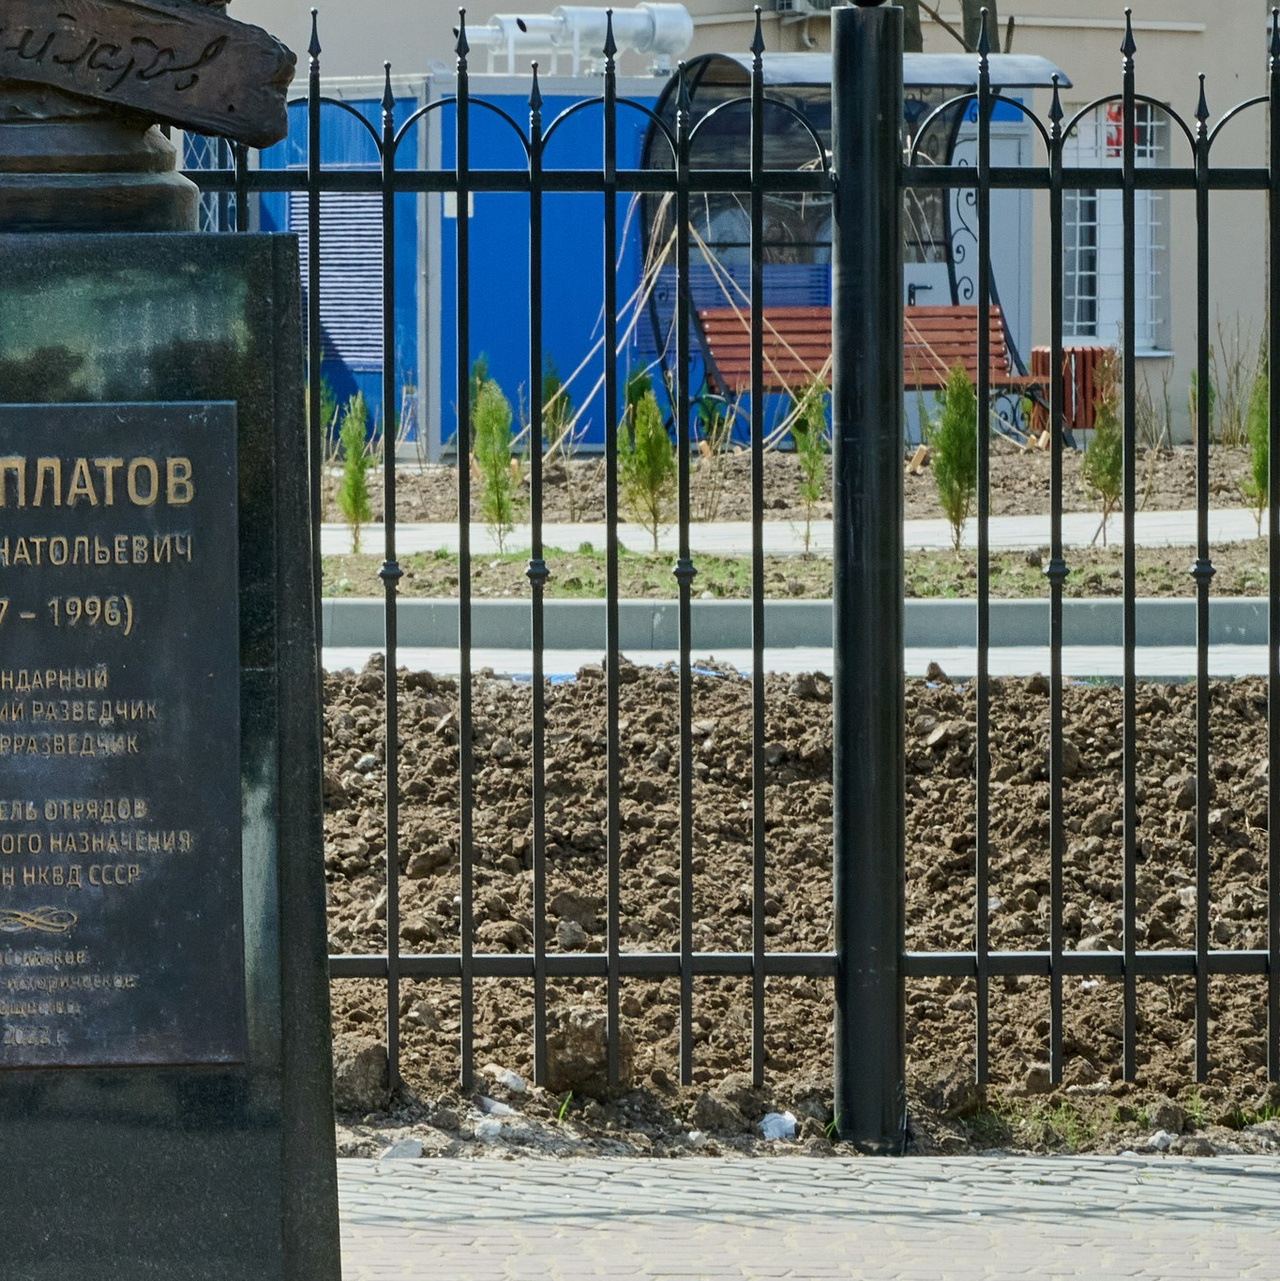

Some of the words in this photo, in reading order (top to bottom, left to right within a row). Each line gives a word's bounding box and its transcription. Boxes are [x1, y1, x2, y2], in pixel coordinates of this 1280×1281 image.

[48, 595, 133, 637] 1996)
[32, 700, 158, 725] РАЗВЕДЧИК
[45, 798, 147, 822] ОТРЯДОВ
[50, 831, 191, 854] НАЗНАЧЕНИЯ
[23, 866, 81, 889] НКВД
[89, 864, 140, 885] СССР
